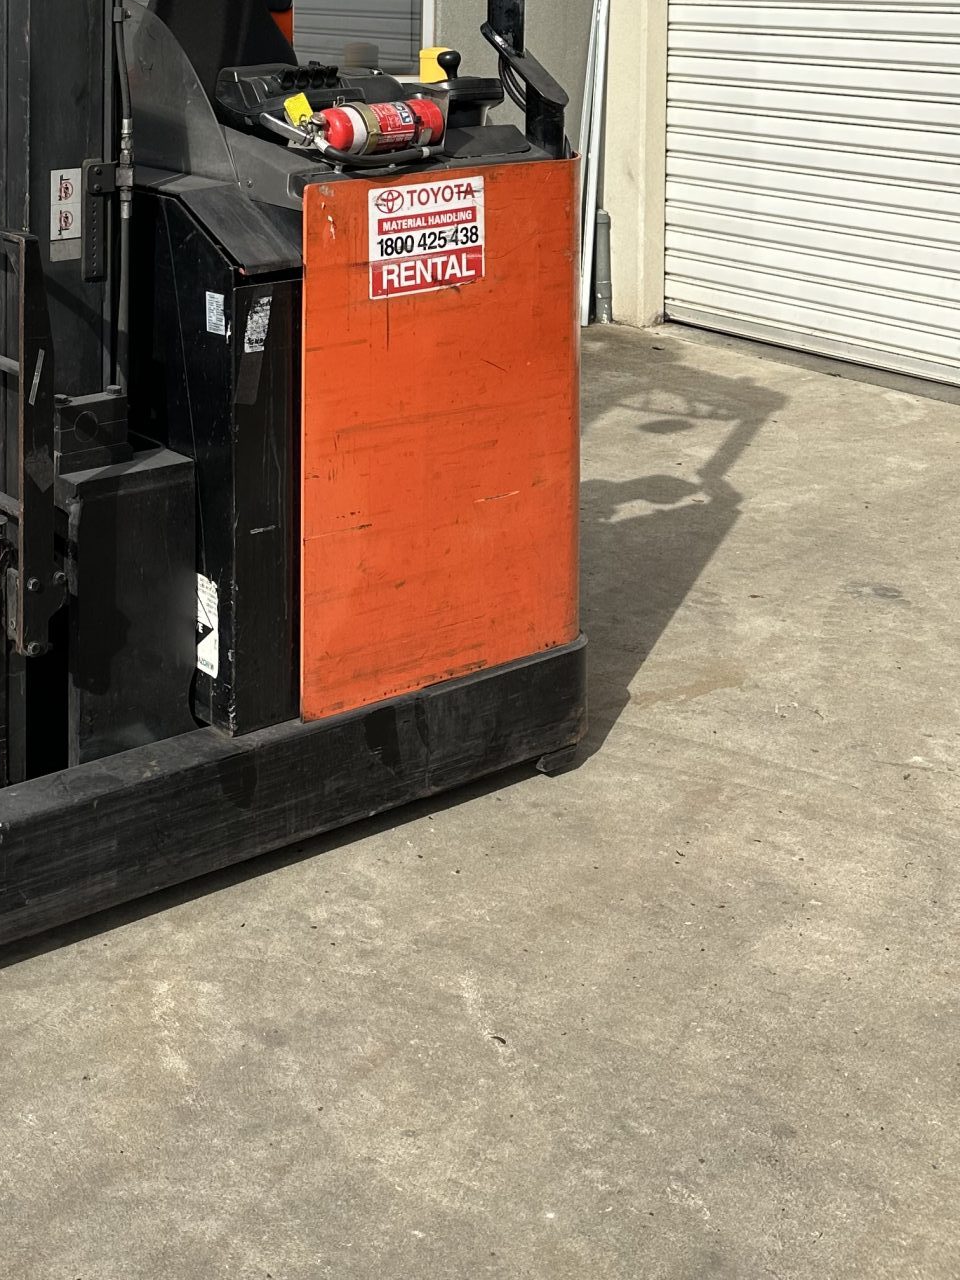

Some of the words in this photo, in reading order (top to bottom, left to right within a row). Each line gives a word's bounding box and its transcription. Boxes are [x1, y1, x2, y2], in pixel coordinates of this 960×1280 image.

[406, 183, 476, 207] TOYOTA
[382, 218, 428, 232] MATERIAL
[427, 210, 473, 226] HANDLING
[377, 235, 415, 257] 1800
[417, 230, 448, 251] 425
[448, 225, 479, 246] 438
[381, 253, 476, 290] RENTAL
